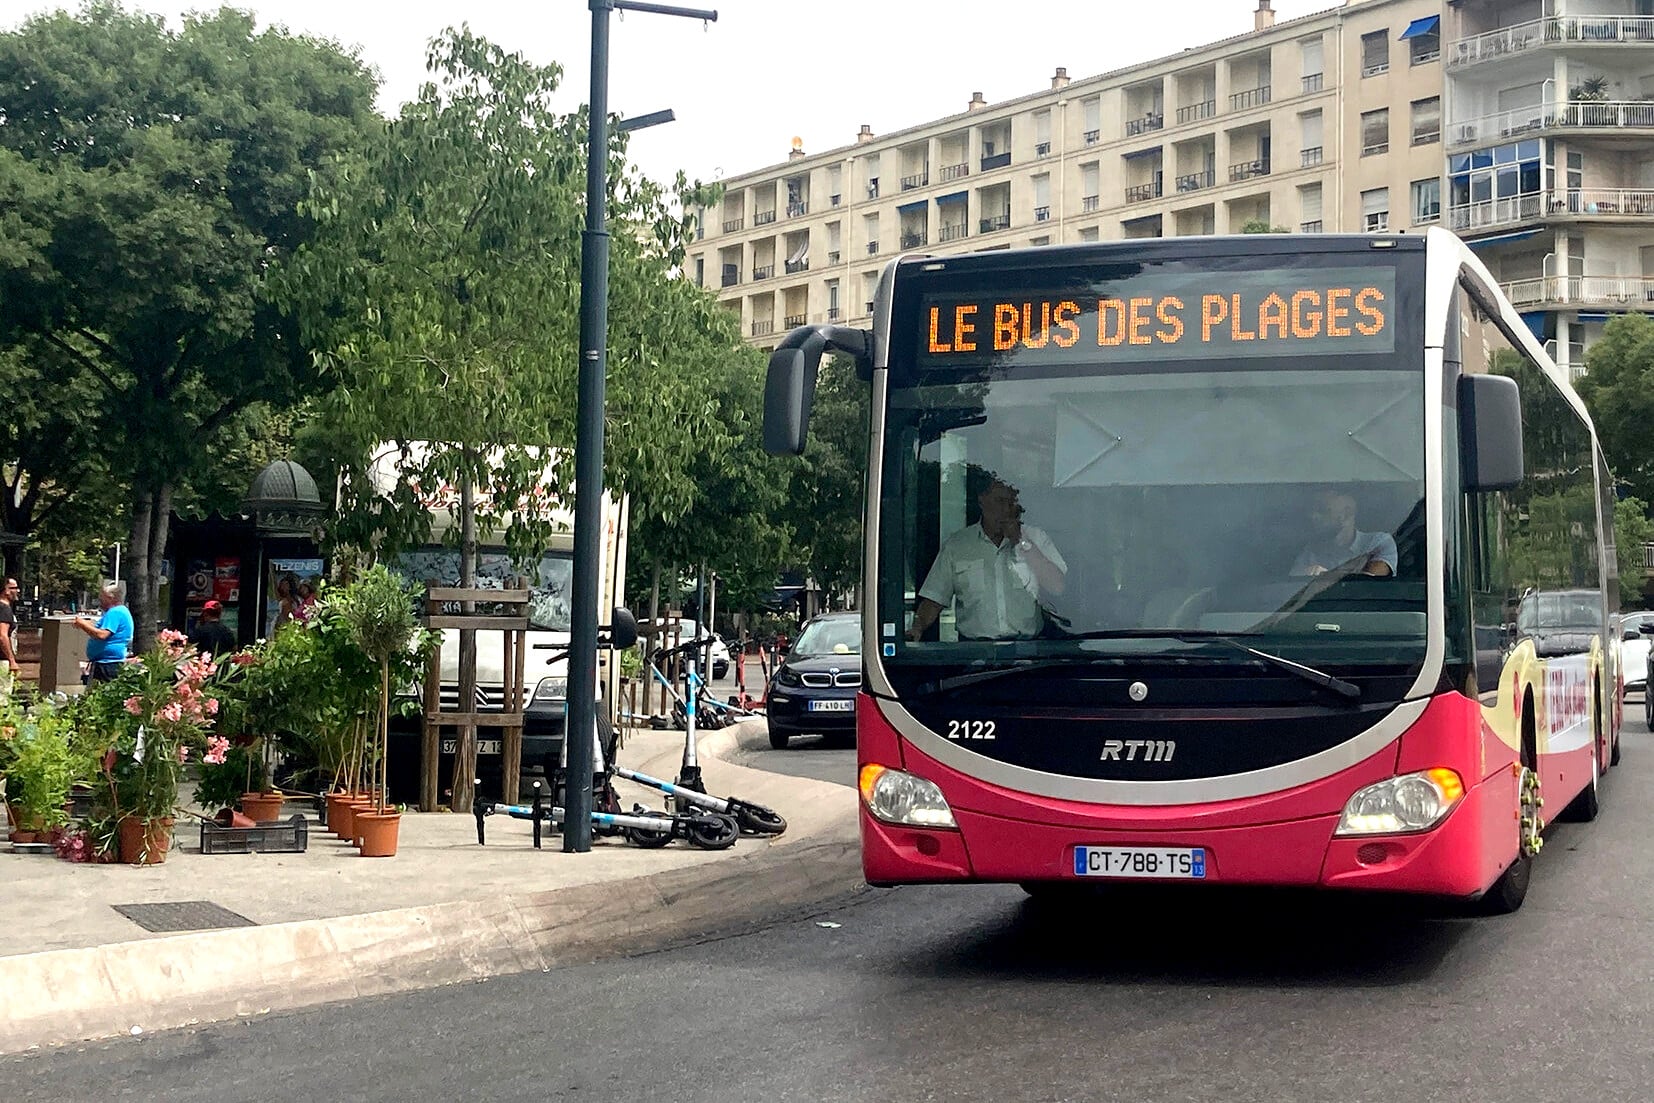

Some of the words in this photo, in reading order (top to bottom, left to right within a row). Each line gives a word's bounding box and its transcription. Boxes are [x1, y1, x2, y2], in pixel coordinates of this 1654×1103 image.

[928, 305, 978, 353] LE
[993, 301, 1081, 348] BUS
[1097, 296, 1184, 346] DES
[1202, 287, 1386, 342] PLAGES
[273, 561, 319, 571] TEZENIS
[948, 720, 996, 740] 2122
